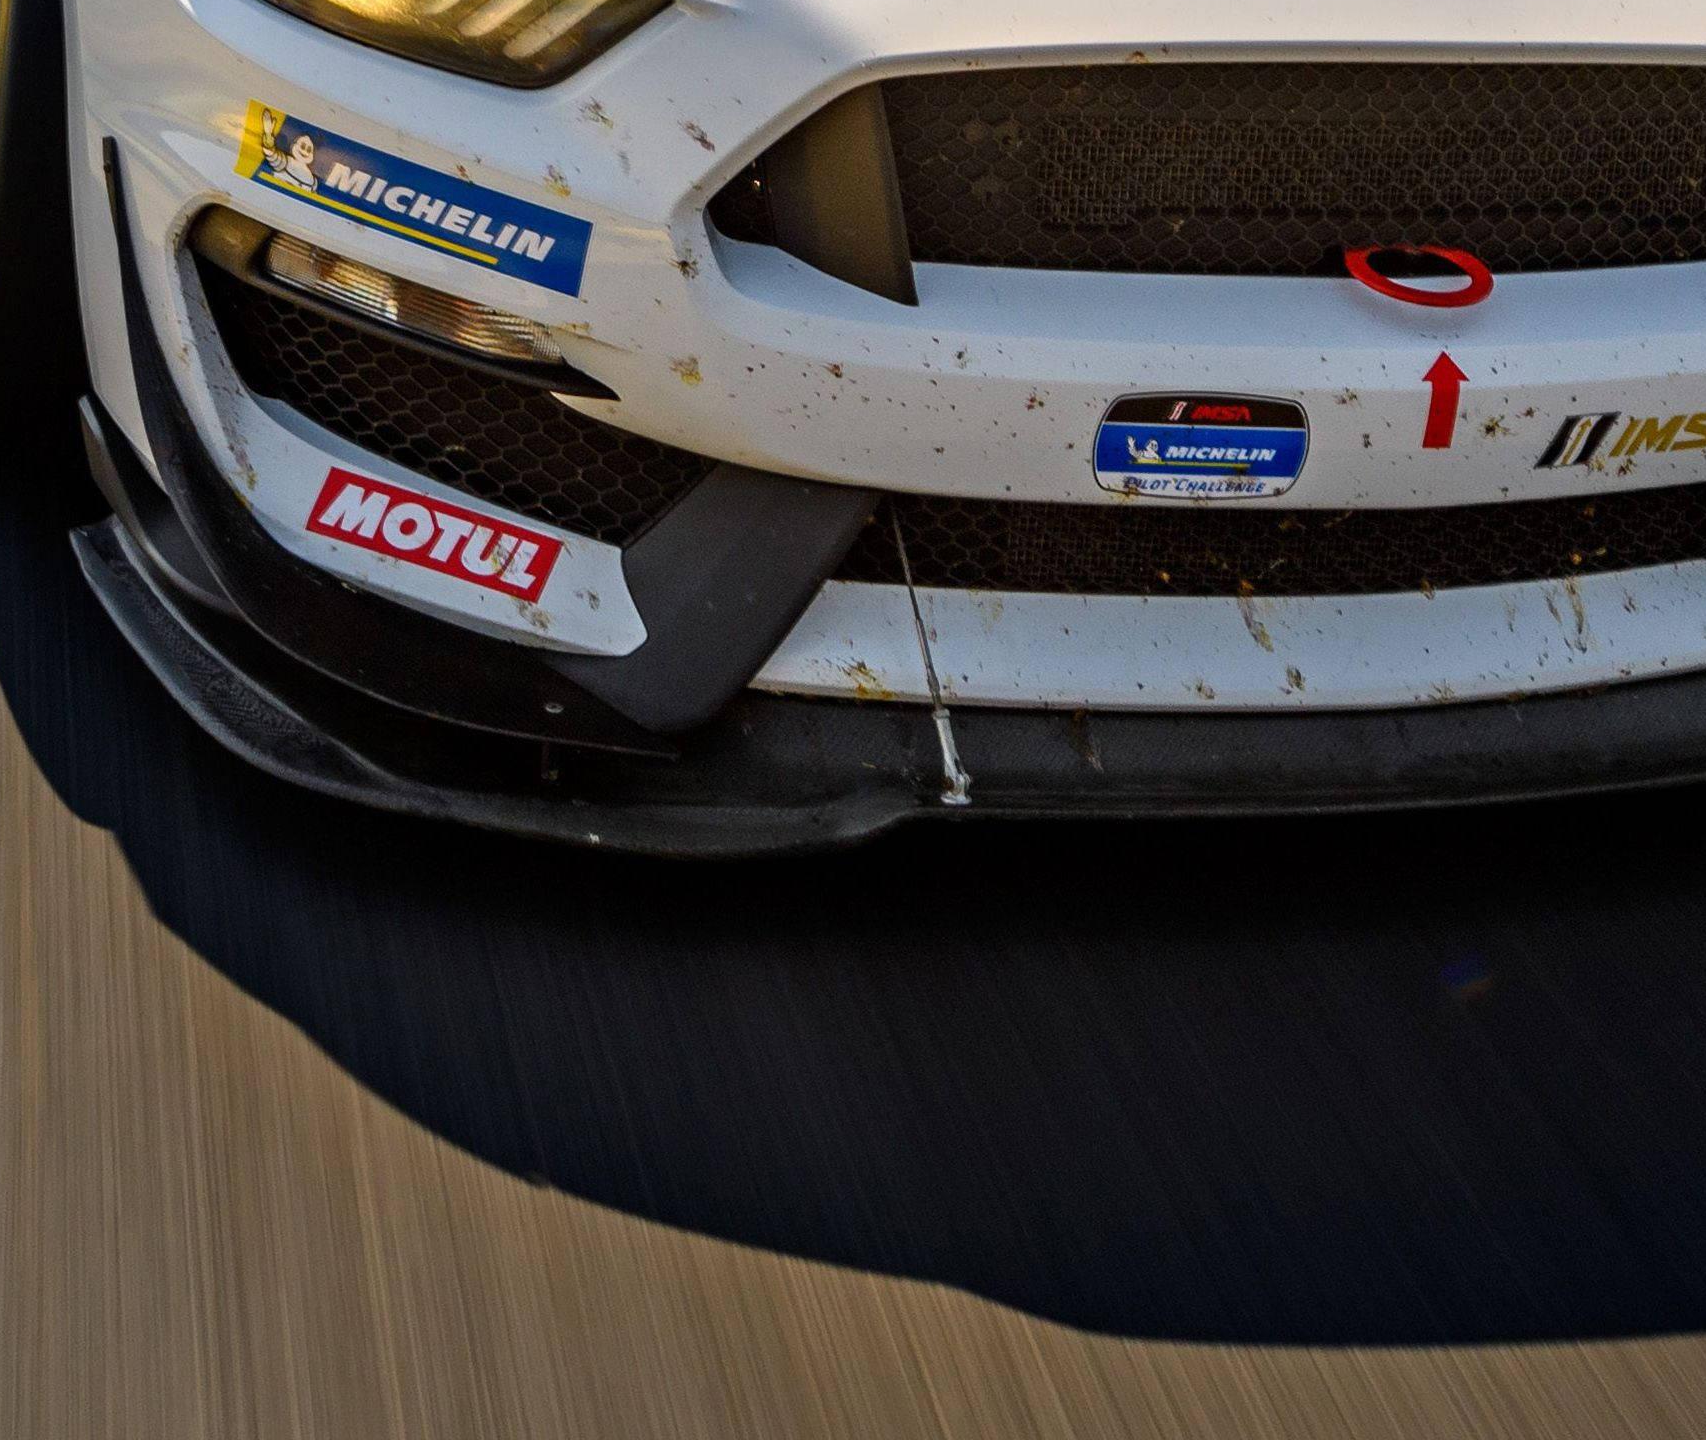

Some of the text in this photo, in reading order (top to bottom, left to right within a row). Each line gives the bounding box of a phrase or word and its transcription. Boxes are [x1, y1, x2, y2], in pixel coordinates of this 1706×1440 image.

[324, 161, 556, 263] MICHELIN
[1164, 445, 1278, 462] MICHELIN
[318, 483, 540, 590] MOTUL
